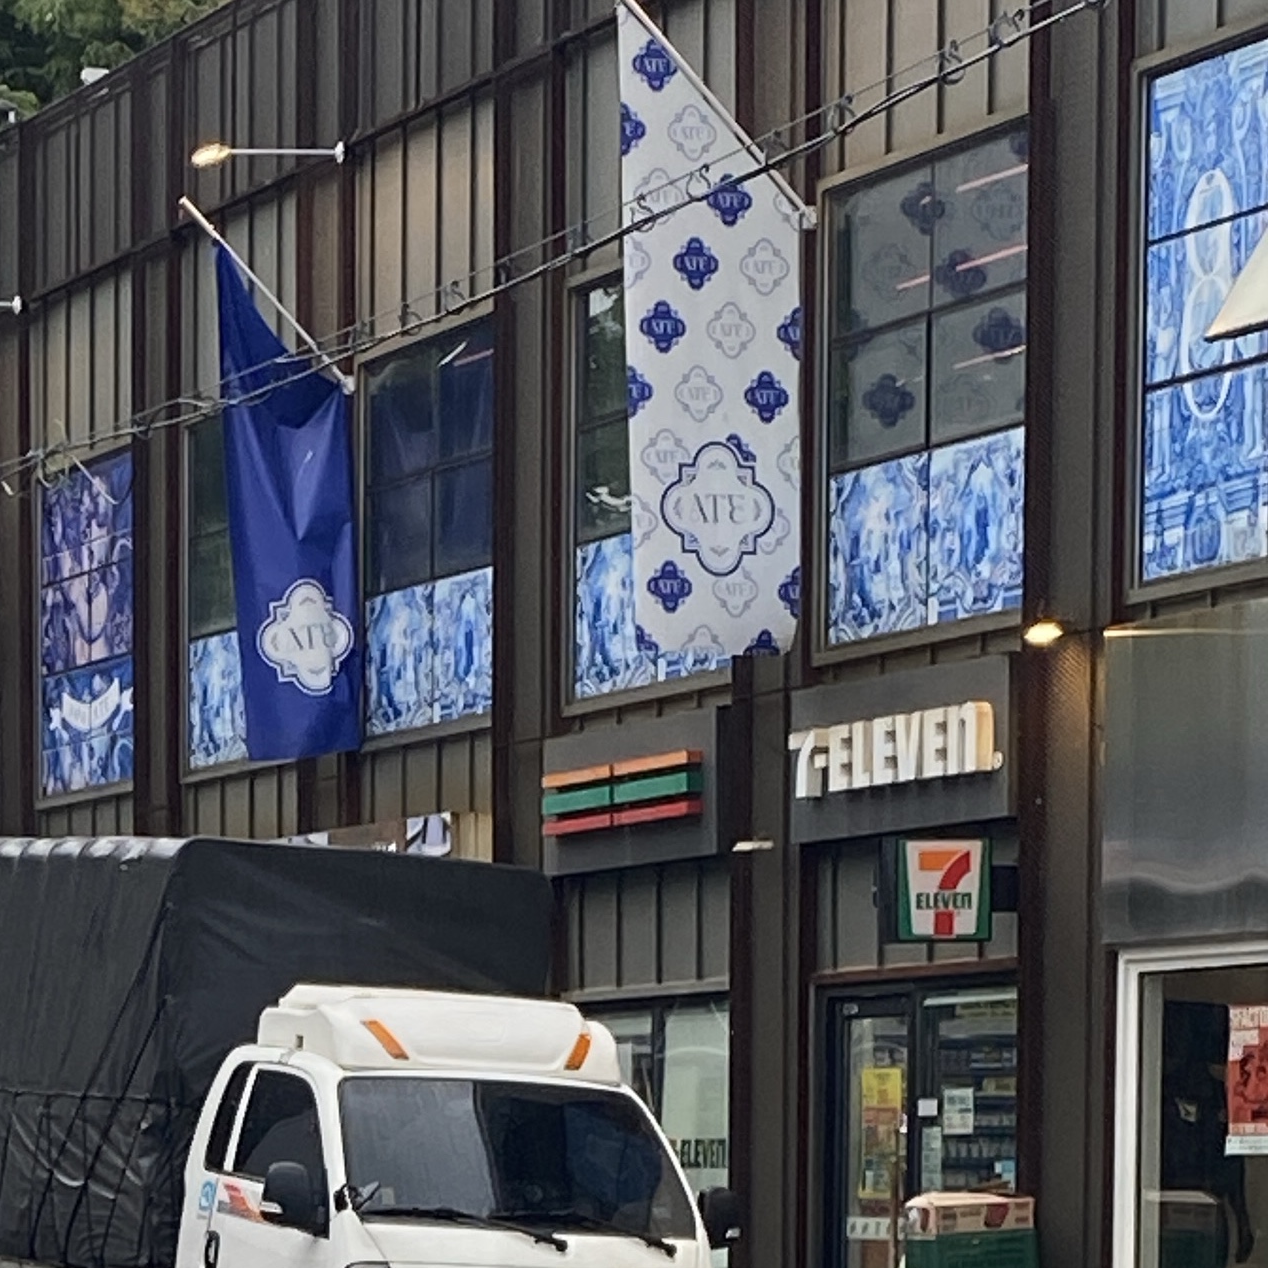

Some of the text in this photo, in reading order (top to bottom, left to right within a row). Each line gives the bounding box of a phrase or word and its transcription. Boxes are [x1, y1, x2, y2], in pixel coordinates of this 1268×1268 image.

[643, 57, 668, 73] ATE
[717, 194, 743, 209] ATE
[683, 255, 708, 271] ATE
[651, 318, 677, 334] ATE
[755, 390, 779, 405] ATE
[692, 493, 747, 525] ATE
[658, 578, 683, 594] ATE
